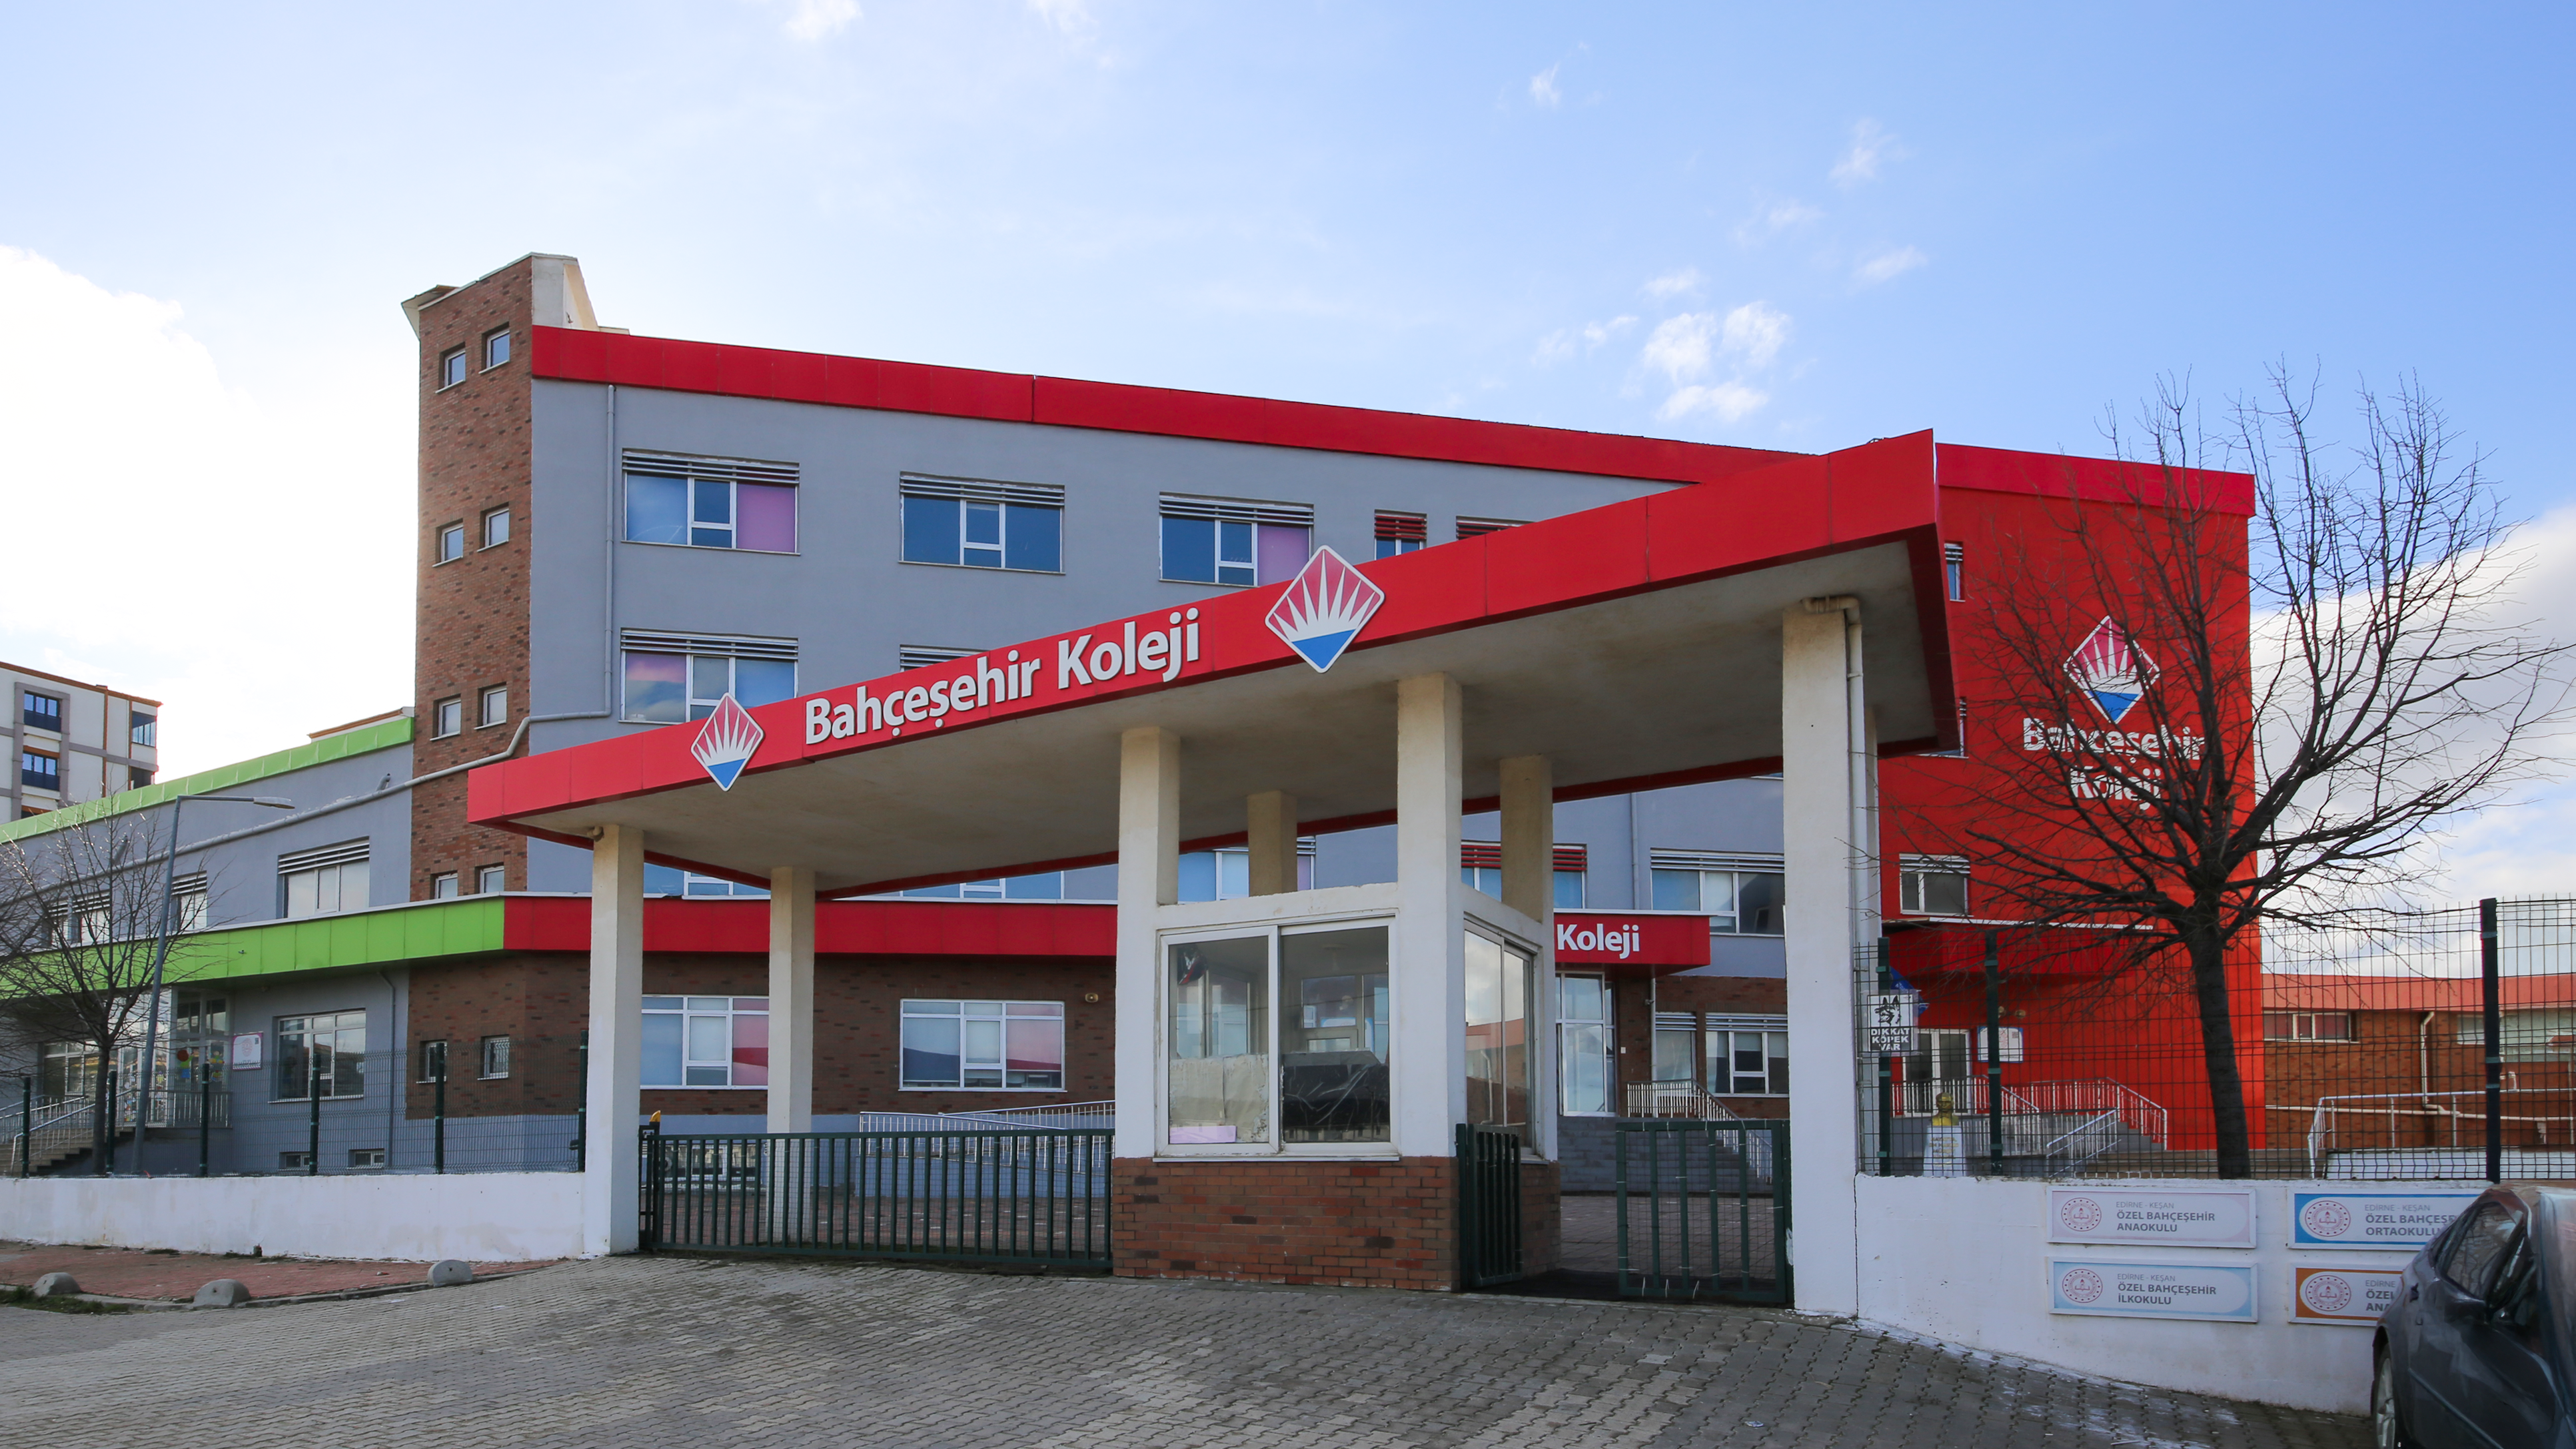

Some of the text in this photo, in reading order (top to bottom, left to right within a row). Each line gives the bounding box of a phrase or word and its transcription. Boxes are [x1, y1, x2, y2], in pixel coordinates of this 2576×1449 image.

[805, 607, 1199, 745] Bahçeşehir Koleji
[1557, 923, 1640, 959] Koleji
[1872, 1035, 1909, 1043] KÖPEK
[2150, 1202, 2174, 1210] KEŞAN
[2365, 1204, 2395, 1212] EDİRNE
[2117, 1209, 2216, 1222] ÖZEL BAHÇEŞEHİR
[2365, 1213, 2397, 1223] ÖZEL
[2117, 1222, 2178, 1232] ANAOKULU
[2118, 1272, 2145, 1281] EDİRNE
[2118, 1281, 2217, 1295] ÖZEL BAHÇEŞEHİR
[2365, 1279, 2396, 1288] EDİRNE
[2118, 1294, 2172, 1305] İLKOKULU
